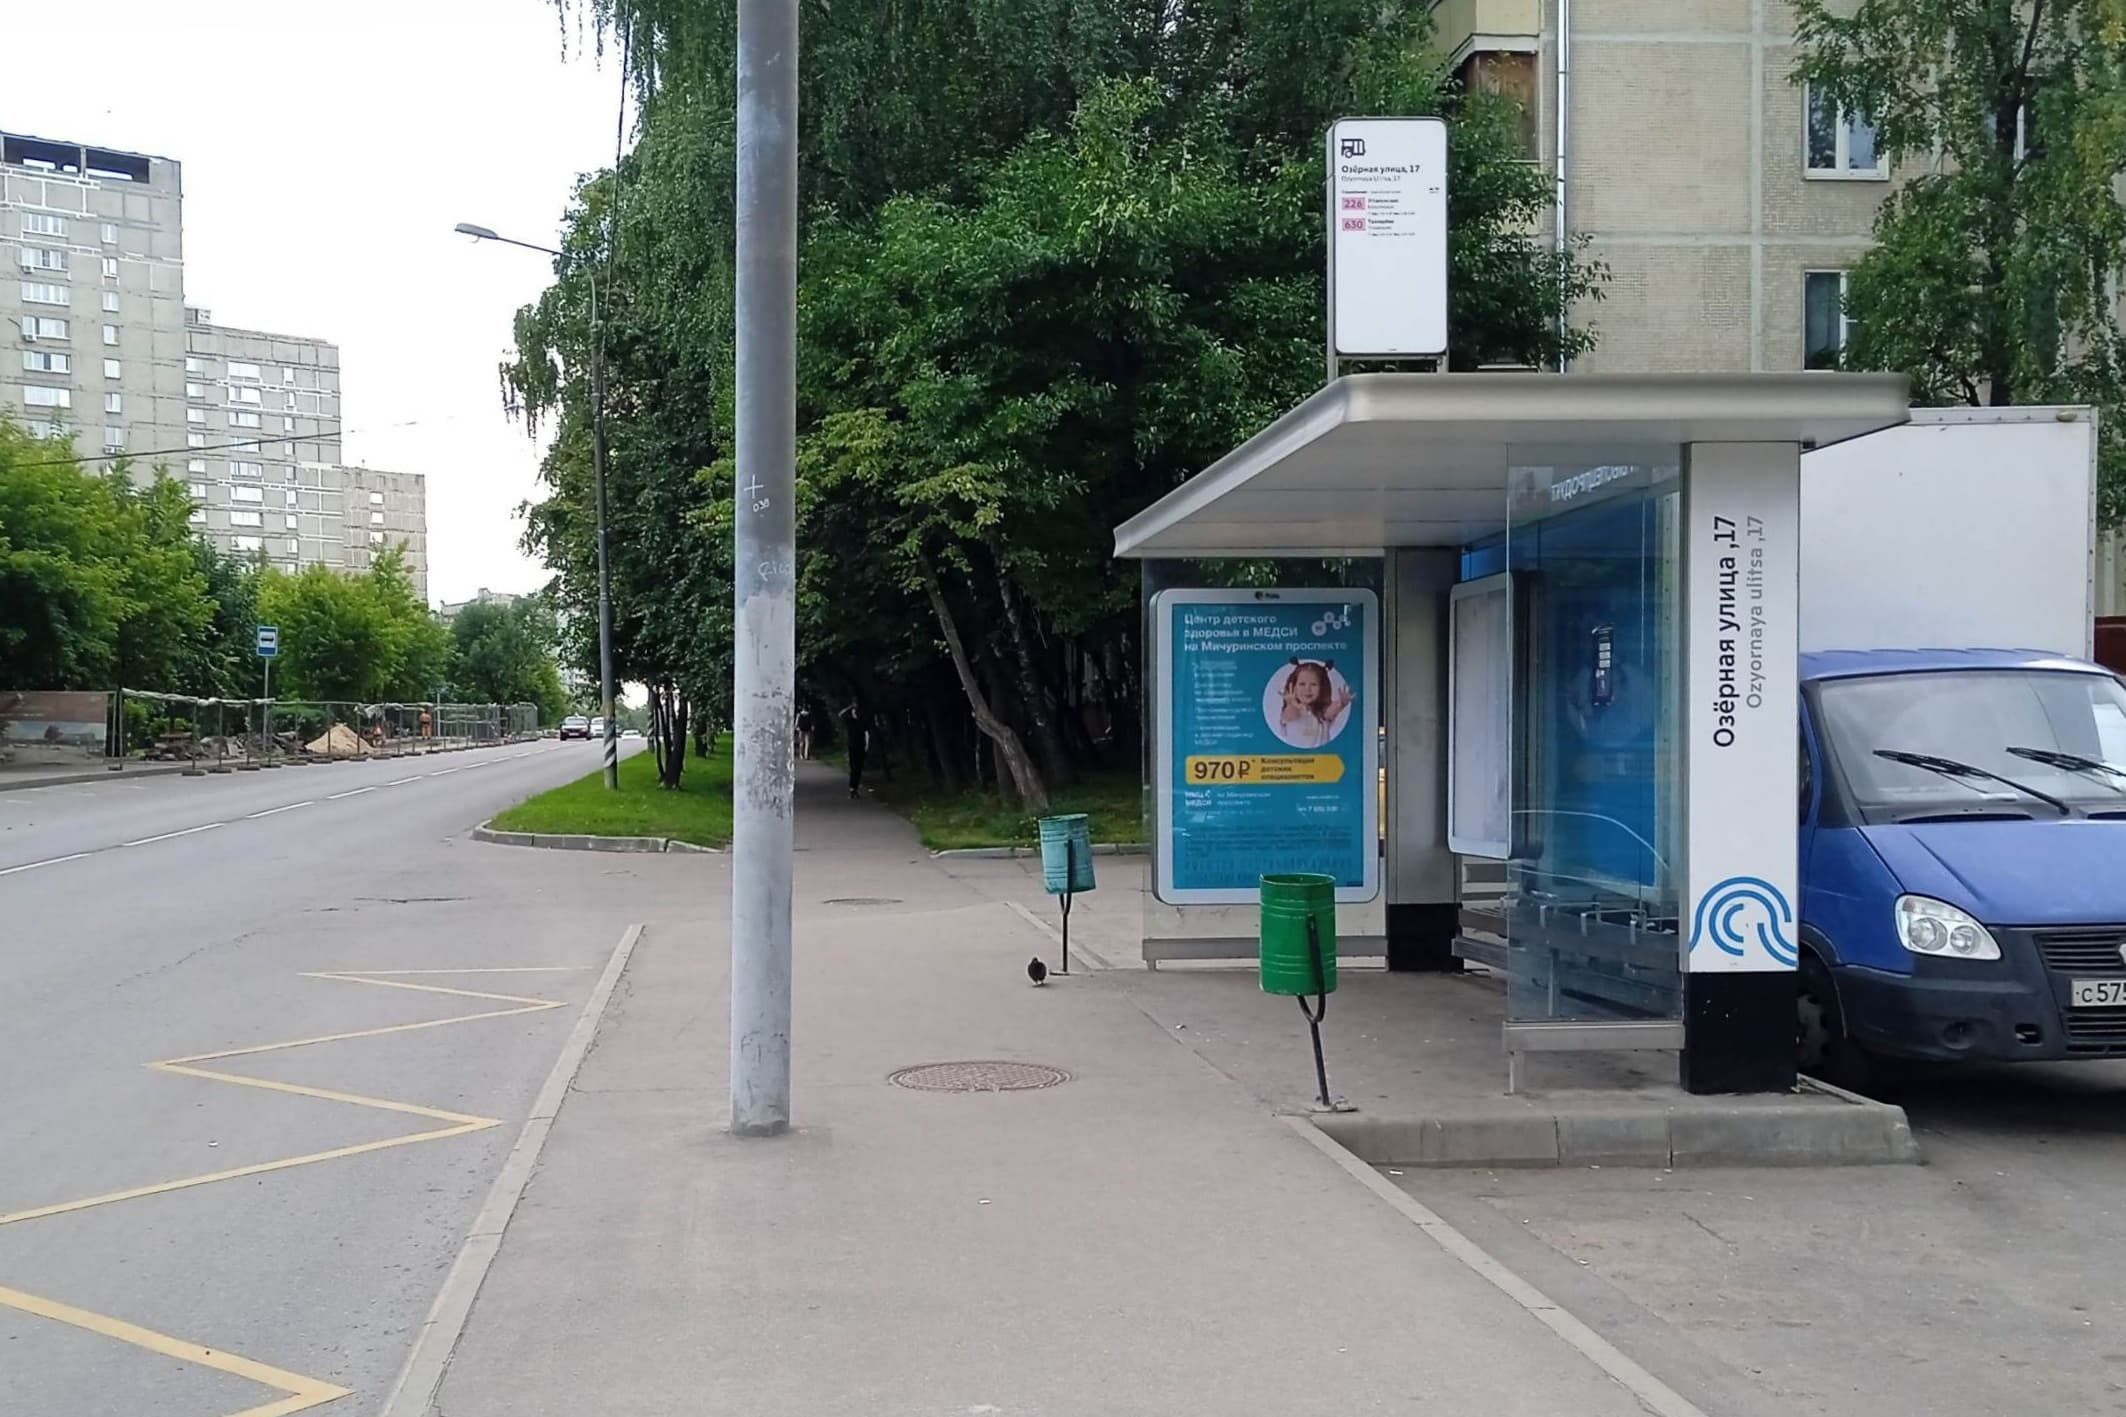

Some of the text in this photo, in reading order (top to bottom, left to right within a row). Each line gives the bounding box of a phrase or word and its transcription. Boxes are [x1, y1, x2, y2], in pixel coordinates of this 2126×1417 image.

[1341, 164, 1378, 174] Озёрная
[1410, 164, 1420, 173] 17
[1344, 200, 1363, 209] 226
[1344, 221, 1364, 230] 630
[1746, 547, 1763, 600] ulitsa
[1719, 556, 1740, 632] улица
[1184, 614, 1277, 626] Центр детского
[1253, 627, 1298, 638] МЕДСИ
[1201, 641, 1283, 653] Мичуринском
[1285, 642, 1347, 652] проспекте
[1746, 605, 1767, 708] Ozyornaya
[1713, 639, 1740, 747] Озёрная
[2081, 982, 2126, 1003] С57
